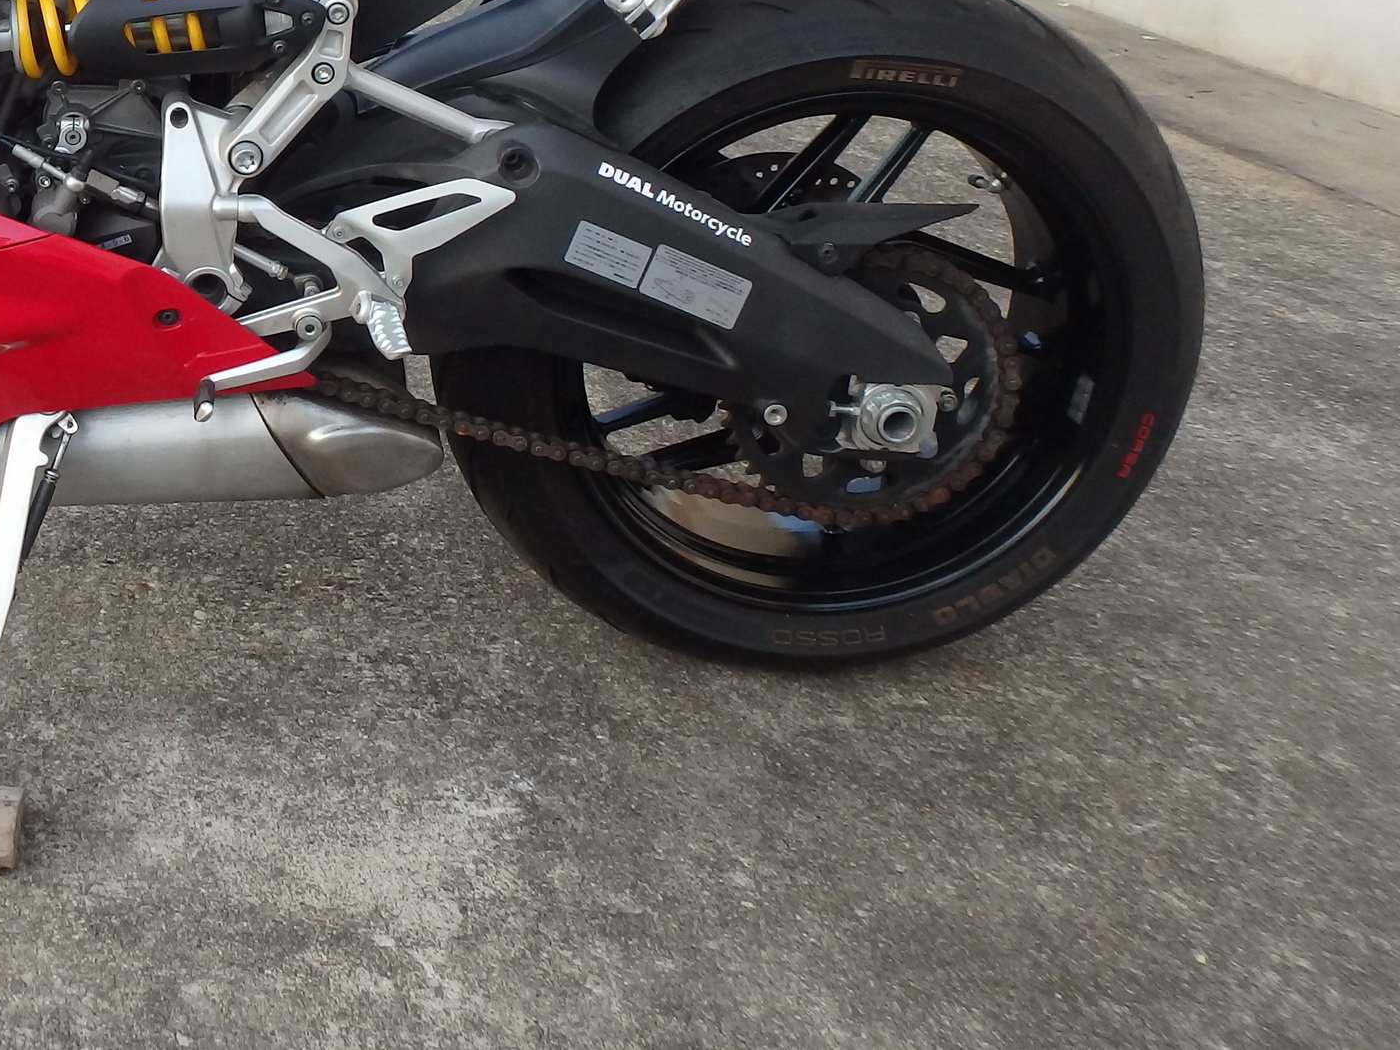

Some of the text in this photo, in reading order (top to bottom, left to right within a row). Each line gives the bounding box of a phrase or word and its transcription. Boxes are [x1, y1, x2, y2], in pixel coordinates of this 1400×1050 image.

[849, 59, 963, 88] PIRELLI
[600, 161, 752, 247] DUAL Motorcycle
[1117, 412, 1156, 478] CORSA
[932, 547, 1057, 626] DIABLO
